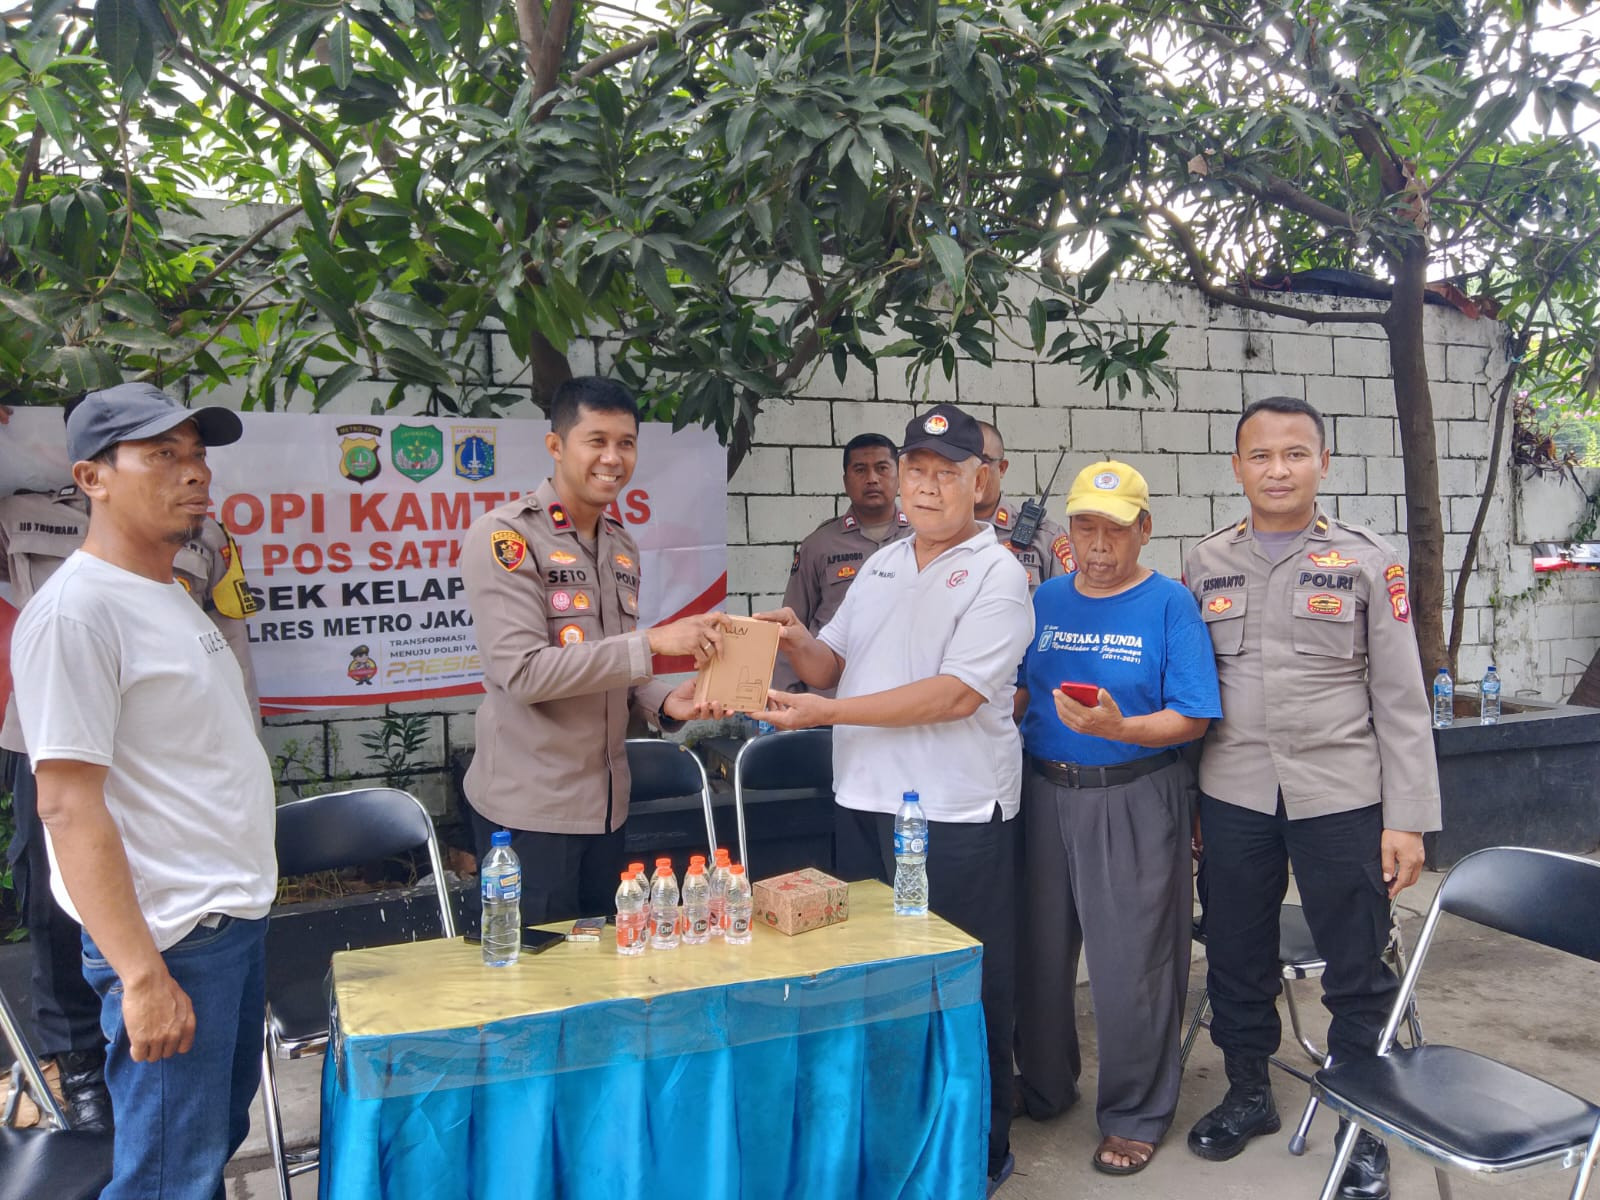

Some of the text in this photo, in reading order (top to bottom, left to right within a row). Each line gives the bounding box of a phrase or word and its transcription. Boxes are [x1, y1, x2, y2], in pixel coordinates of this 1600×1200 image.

[262, 541, 354, 577] POS
[548, 569, 586, 583] SETO
[1202, 574, 1246, 593] SISWANTO
[1300, 571, 1353, 591] POLRI
[341, 577, 466, 607] KELAP
[247, 619, 314, 643] LRES
[323, 613, 412, 638] METRO
[389, 634, 466, 647] TRANSFORMASI
[1053, 631, 1143, 648] PUSTAKA SUNDA
[390, 648, 431, 659] MENUJU
[433, 645, 463, 656] POLRI
